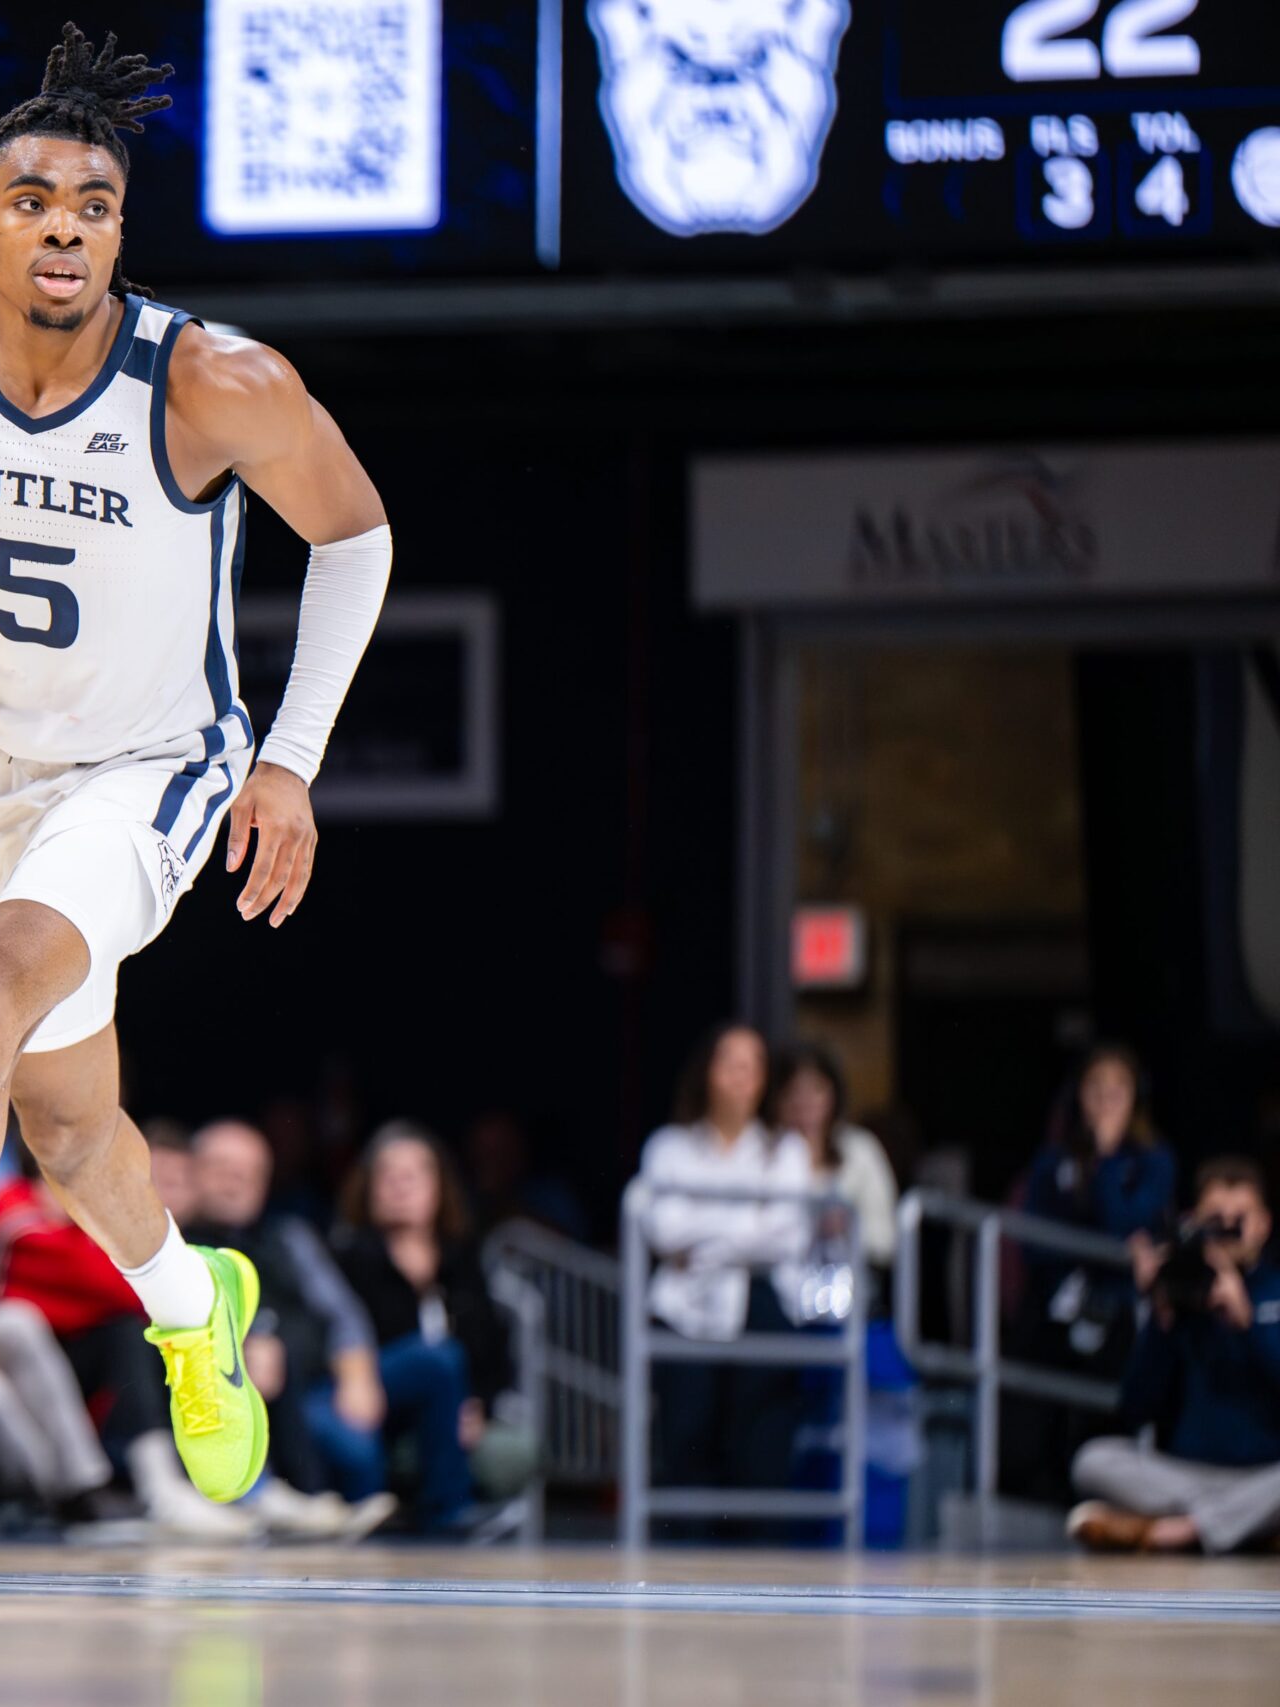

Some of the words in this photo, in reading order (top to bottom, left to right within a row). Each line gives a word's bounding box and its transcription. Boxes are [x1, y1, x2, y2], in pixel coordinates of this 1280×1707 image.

[1001, 0, 1200, 82] 22
[1042, 157, 1094, 229] 3
[1135, 155, 1190, 226] 4
[87, 441, 129, 451] EAST
[91, 432, 122, 442] BIG
